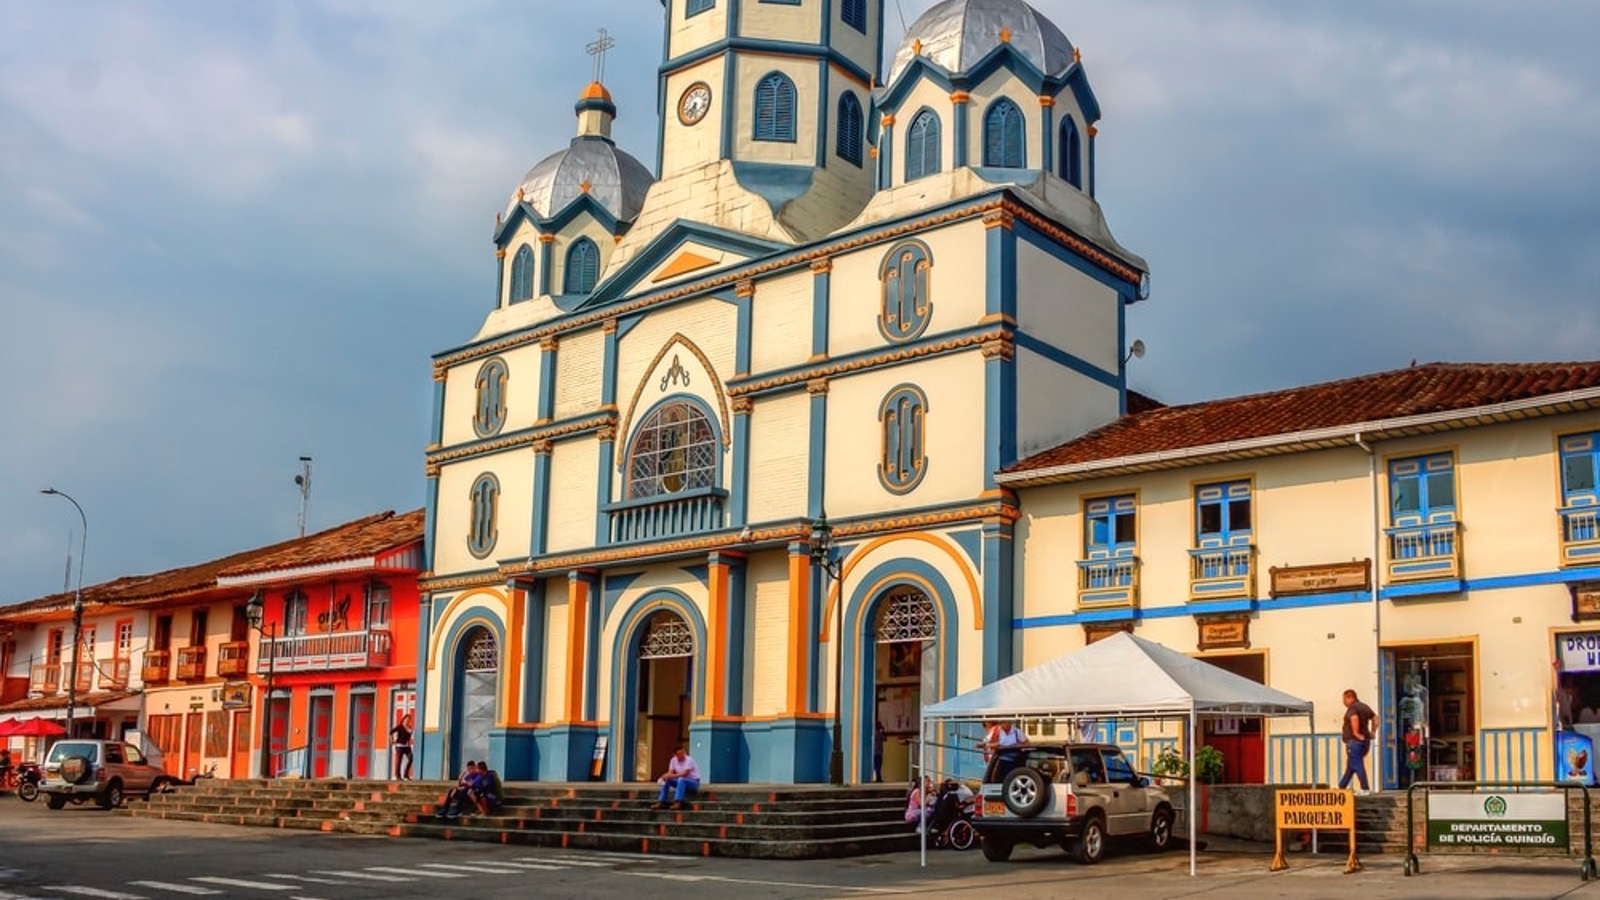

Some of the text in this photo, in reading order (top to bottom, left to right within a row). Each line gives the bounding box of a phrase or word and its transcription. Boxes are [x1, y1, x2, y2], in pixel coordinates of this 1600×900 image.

[1279, 792, 1346, 806] PROHIBIDO
[1284, 811, 1343, 825] PARQUEAR
[1451, 824, 1542, 832] DEPARTAMENTO
[1439, 833, 1555, 844] DE POLICÍA QUINDÍO
